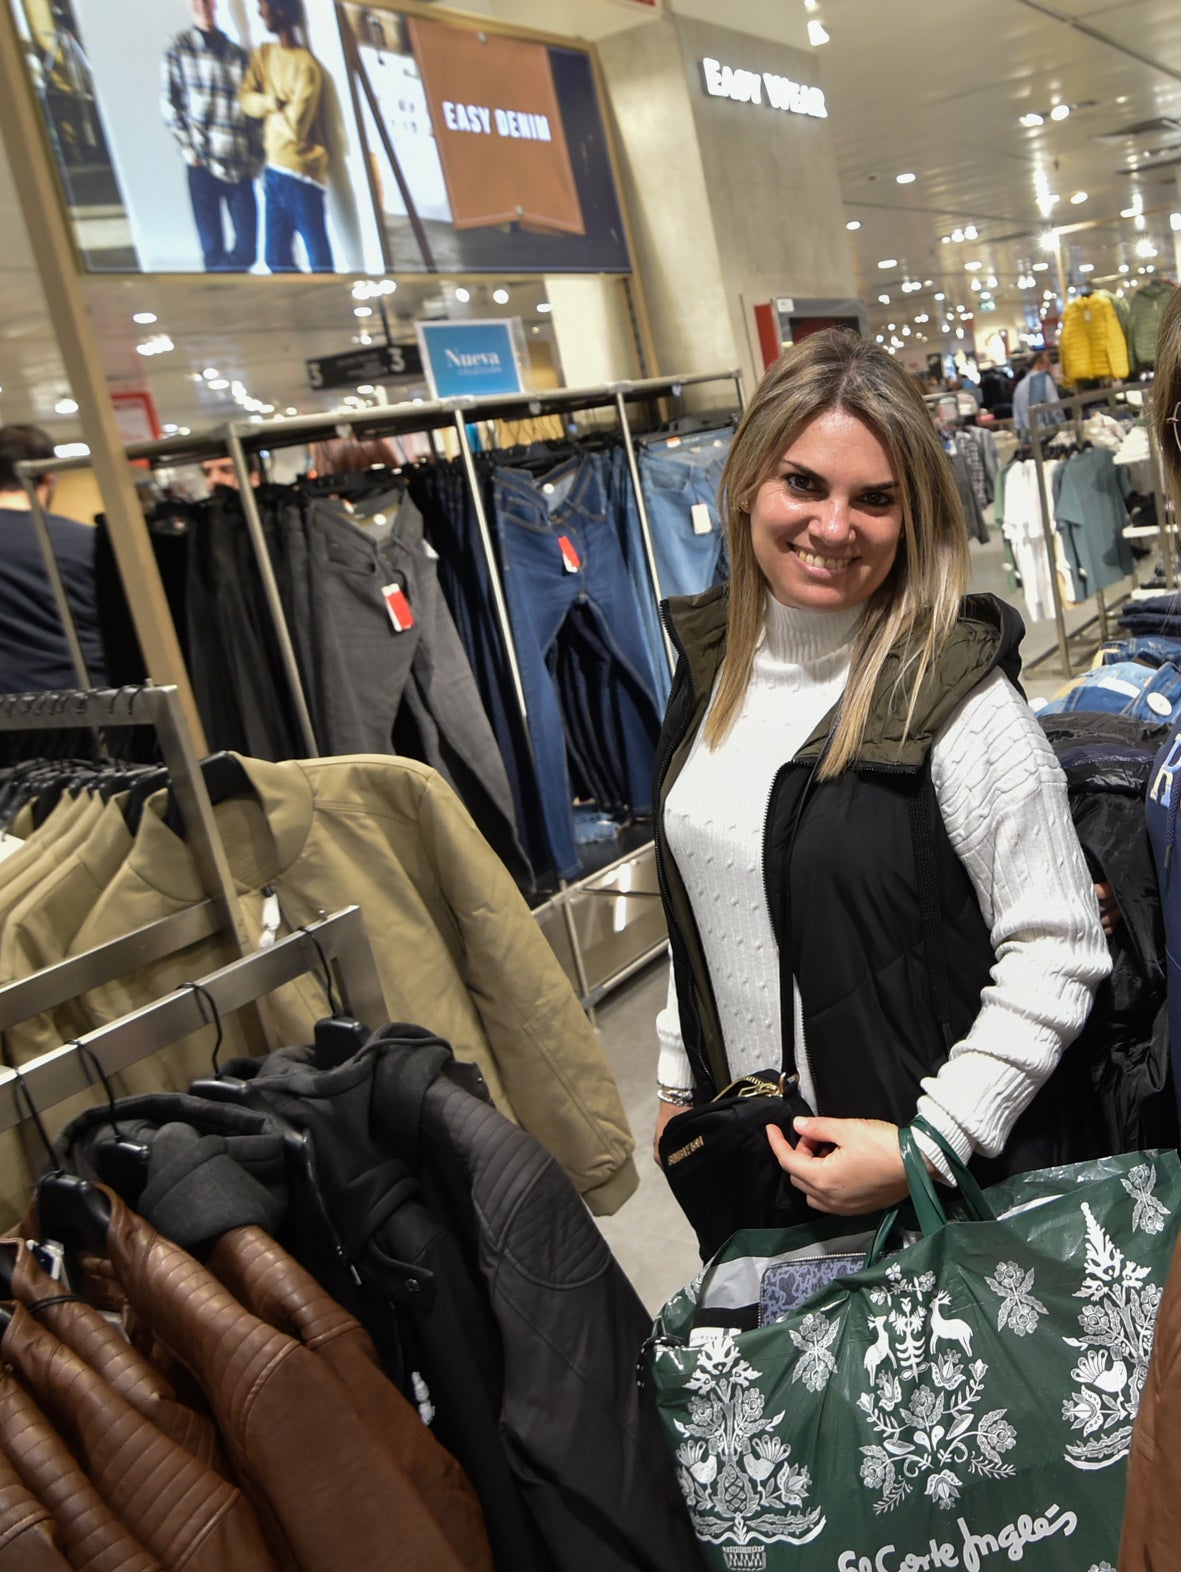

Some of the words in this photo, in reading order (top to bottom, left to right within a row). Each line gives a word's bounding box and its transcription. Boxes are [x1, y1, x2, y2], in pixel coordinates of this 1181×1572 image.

[442, 101, 491, 134] EASY
[495, 109, 552, 141] DENIM
[445, 348, 500, 368] Nueva
[875, 1538, 960, 1572] Corte
[956, 1503, 1078, 1572] Inglés
